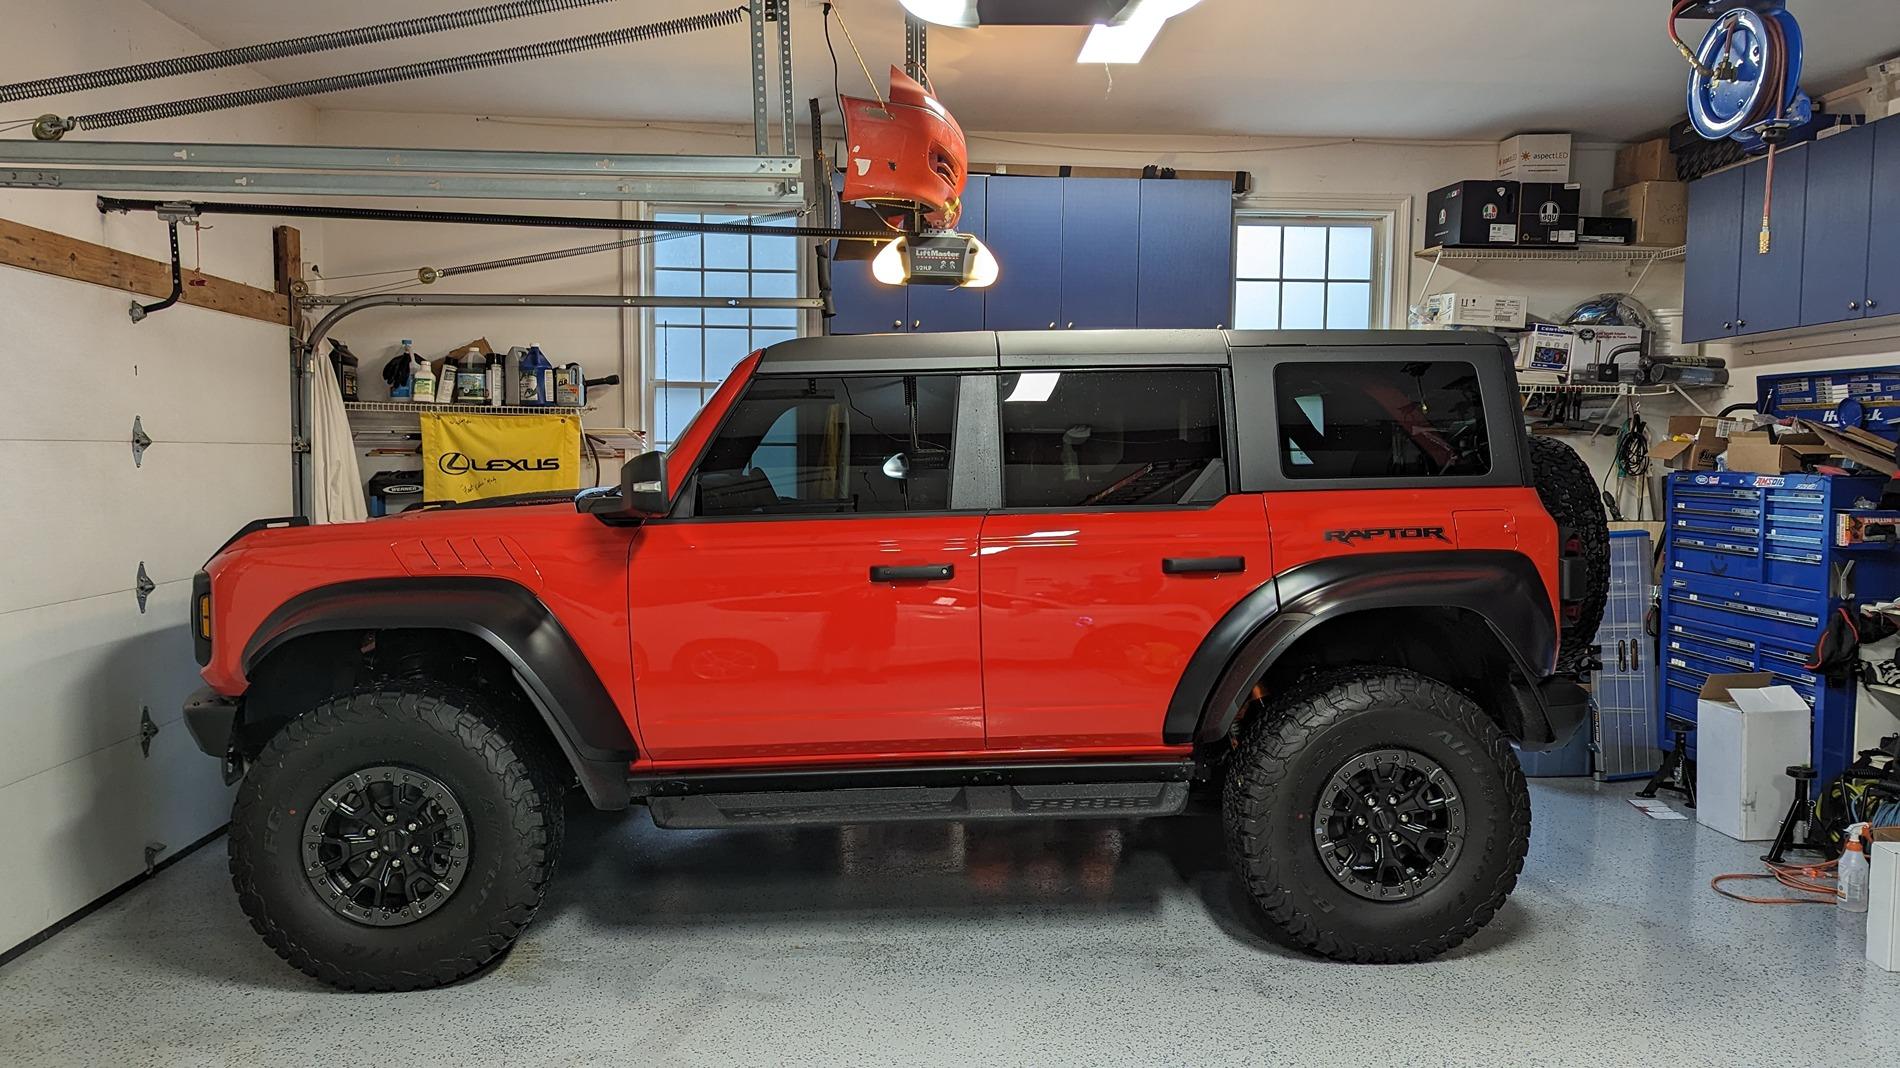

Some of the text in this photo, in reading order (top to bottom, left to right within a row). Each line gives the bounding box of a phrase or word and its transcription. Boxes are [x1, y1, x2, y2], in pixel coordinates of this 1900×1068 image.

[1533, 152, 1569, 160] aspectLED
[471, 458, 559, 471] LEXUS
[1755, 477, 1784, 486] AMSOIL
[1325, 526, 1452, 547] RAPTOR
